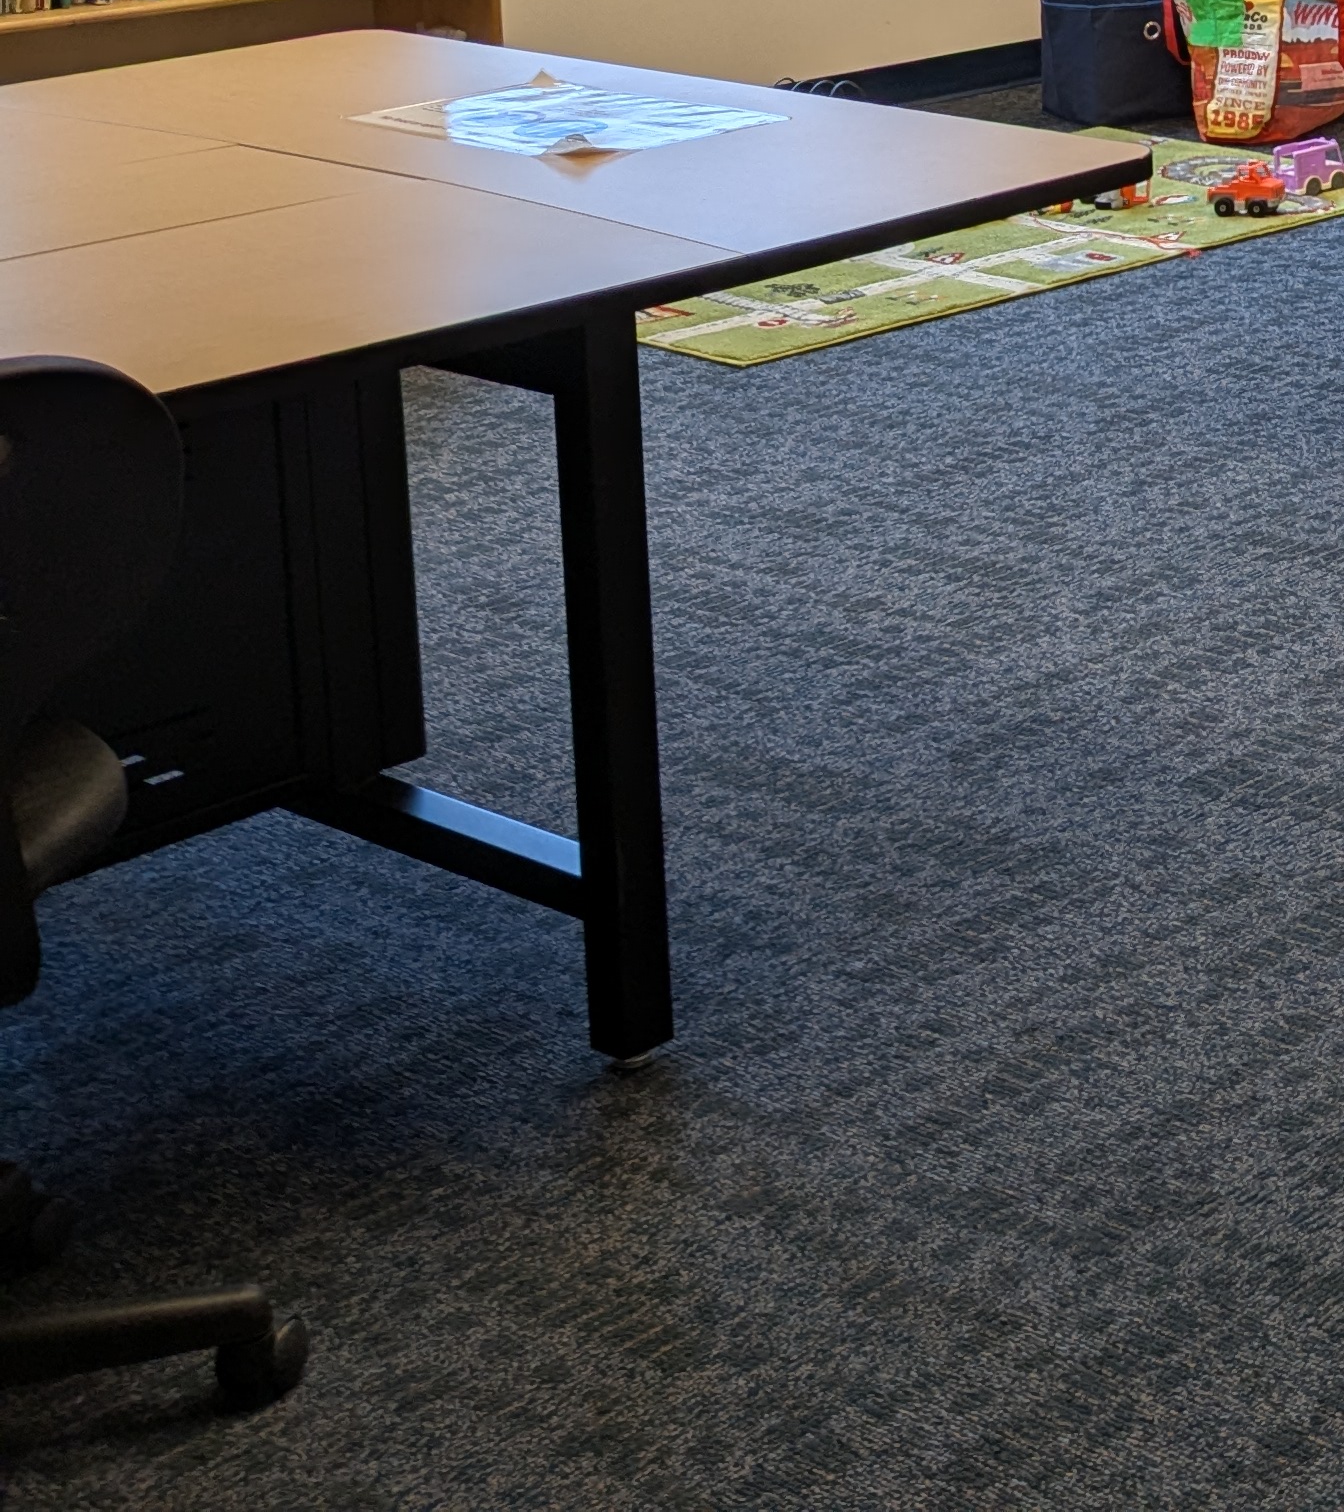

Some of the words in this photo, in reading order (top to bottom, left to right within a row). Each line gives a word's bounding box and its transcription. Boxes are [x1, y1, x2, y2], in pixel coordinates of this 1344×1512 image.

[1222, 49, 1270, 62] PROUDLY
[1256, 63, 1269, 77] BY
[1216, 96, 1266, 111] SINCE
